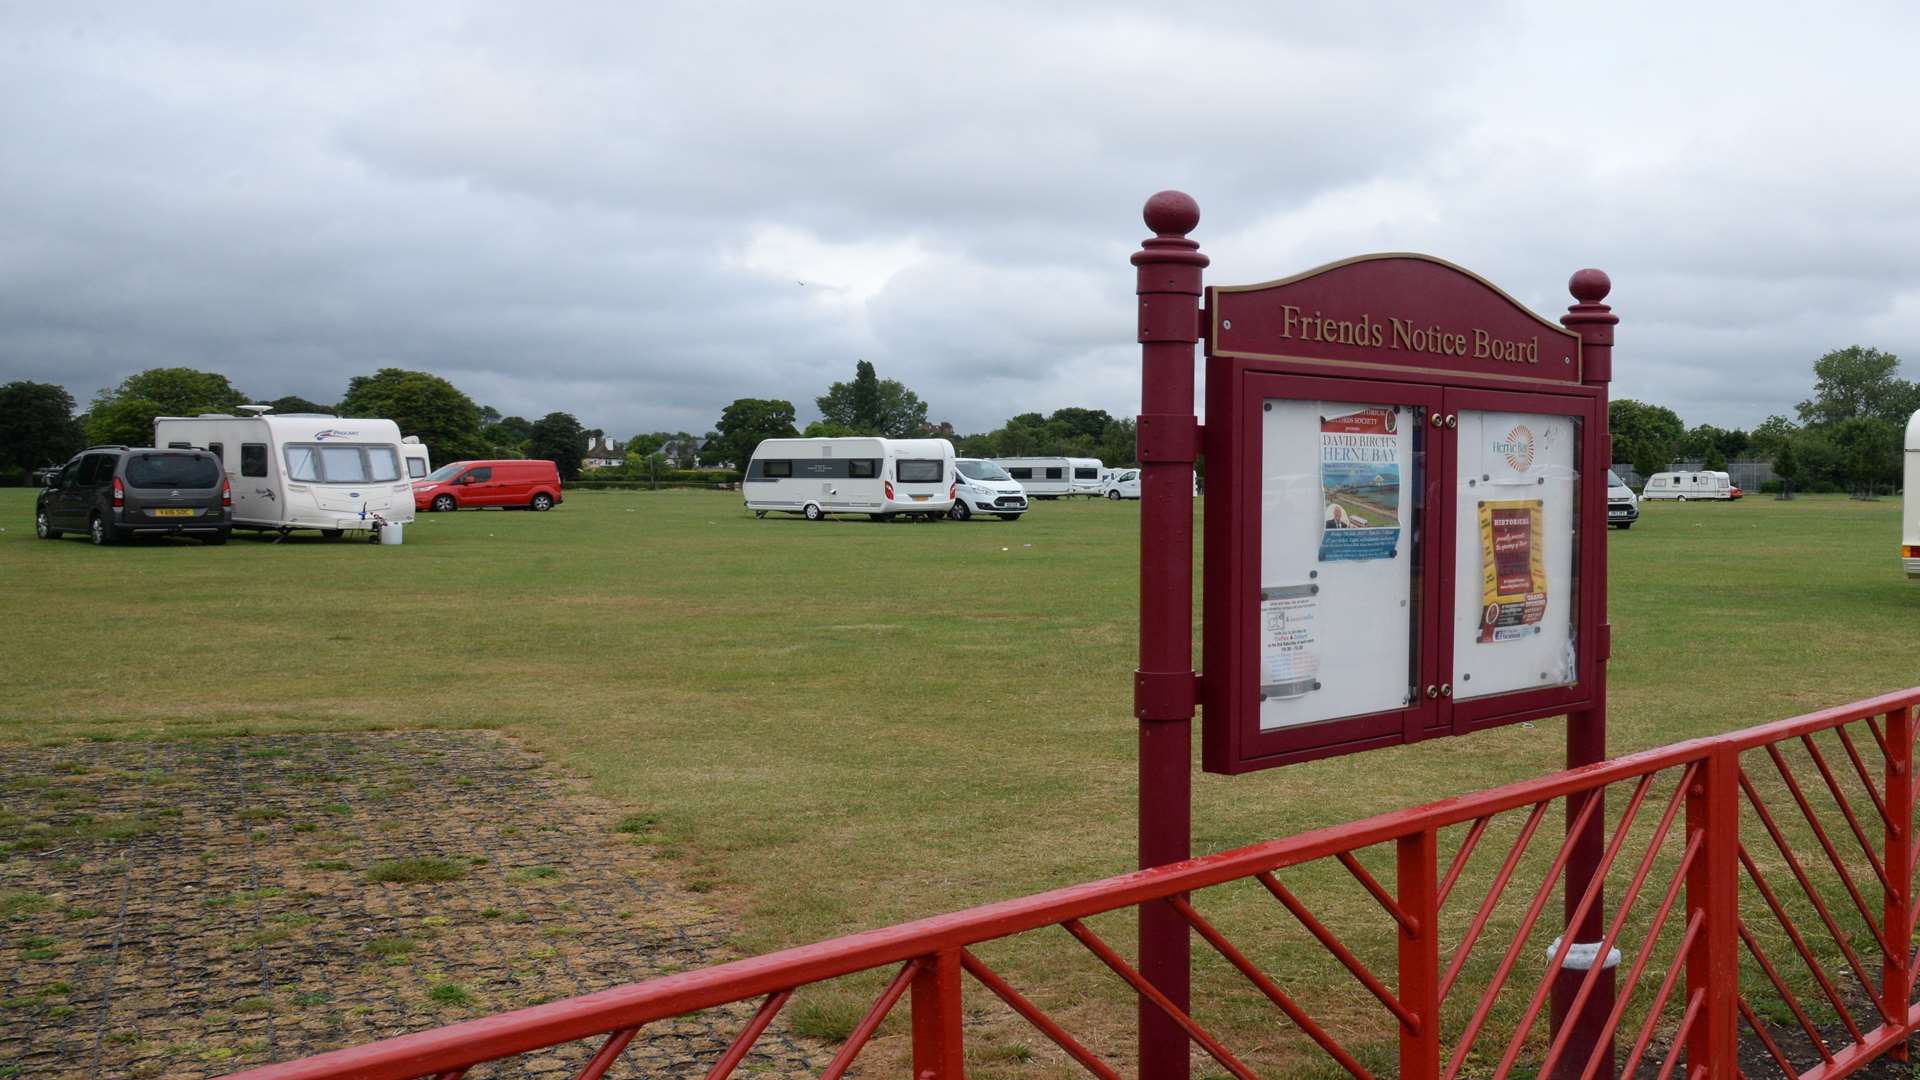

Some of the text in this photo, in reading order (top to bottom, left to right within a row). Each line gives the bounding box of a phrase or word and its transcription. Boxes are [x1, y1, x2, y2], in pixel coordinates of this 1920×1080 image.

[1280, 304, 1540, 364] Friends Notice Board
[1323, 435, 1397, 448] DAVID BIRCH'S
[1492, 440, 1517, 453] Herne
[1323, 447, 1395, 462] HERNE BAY
